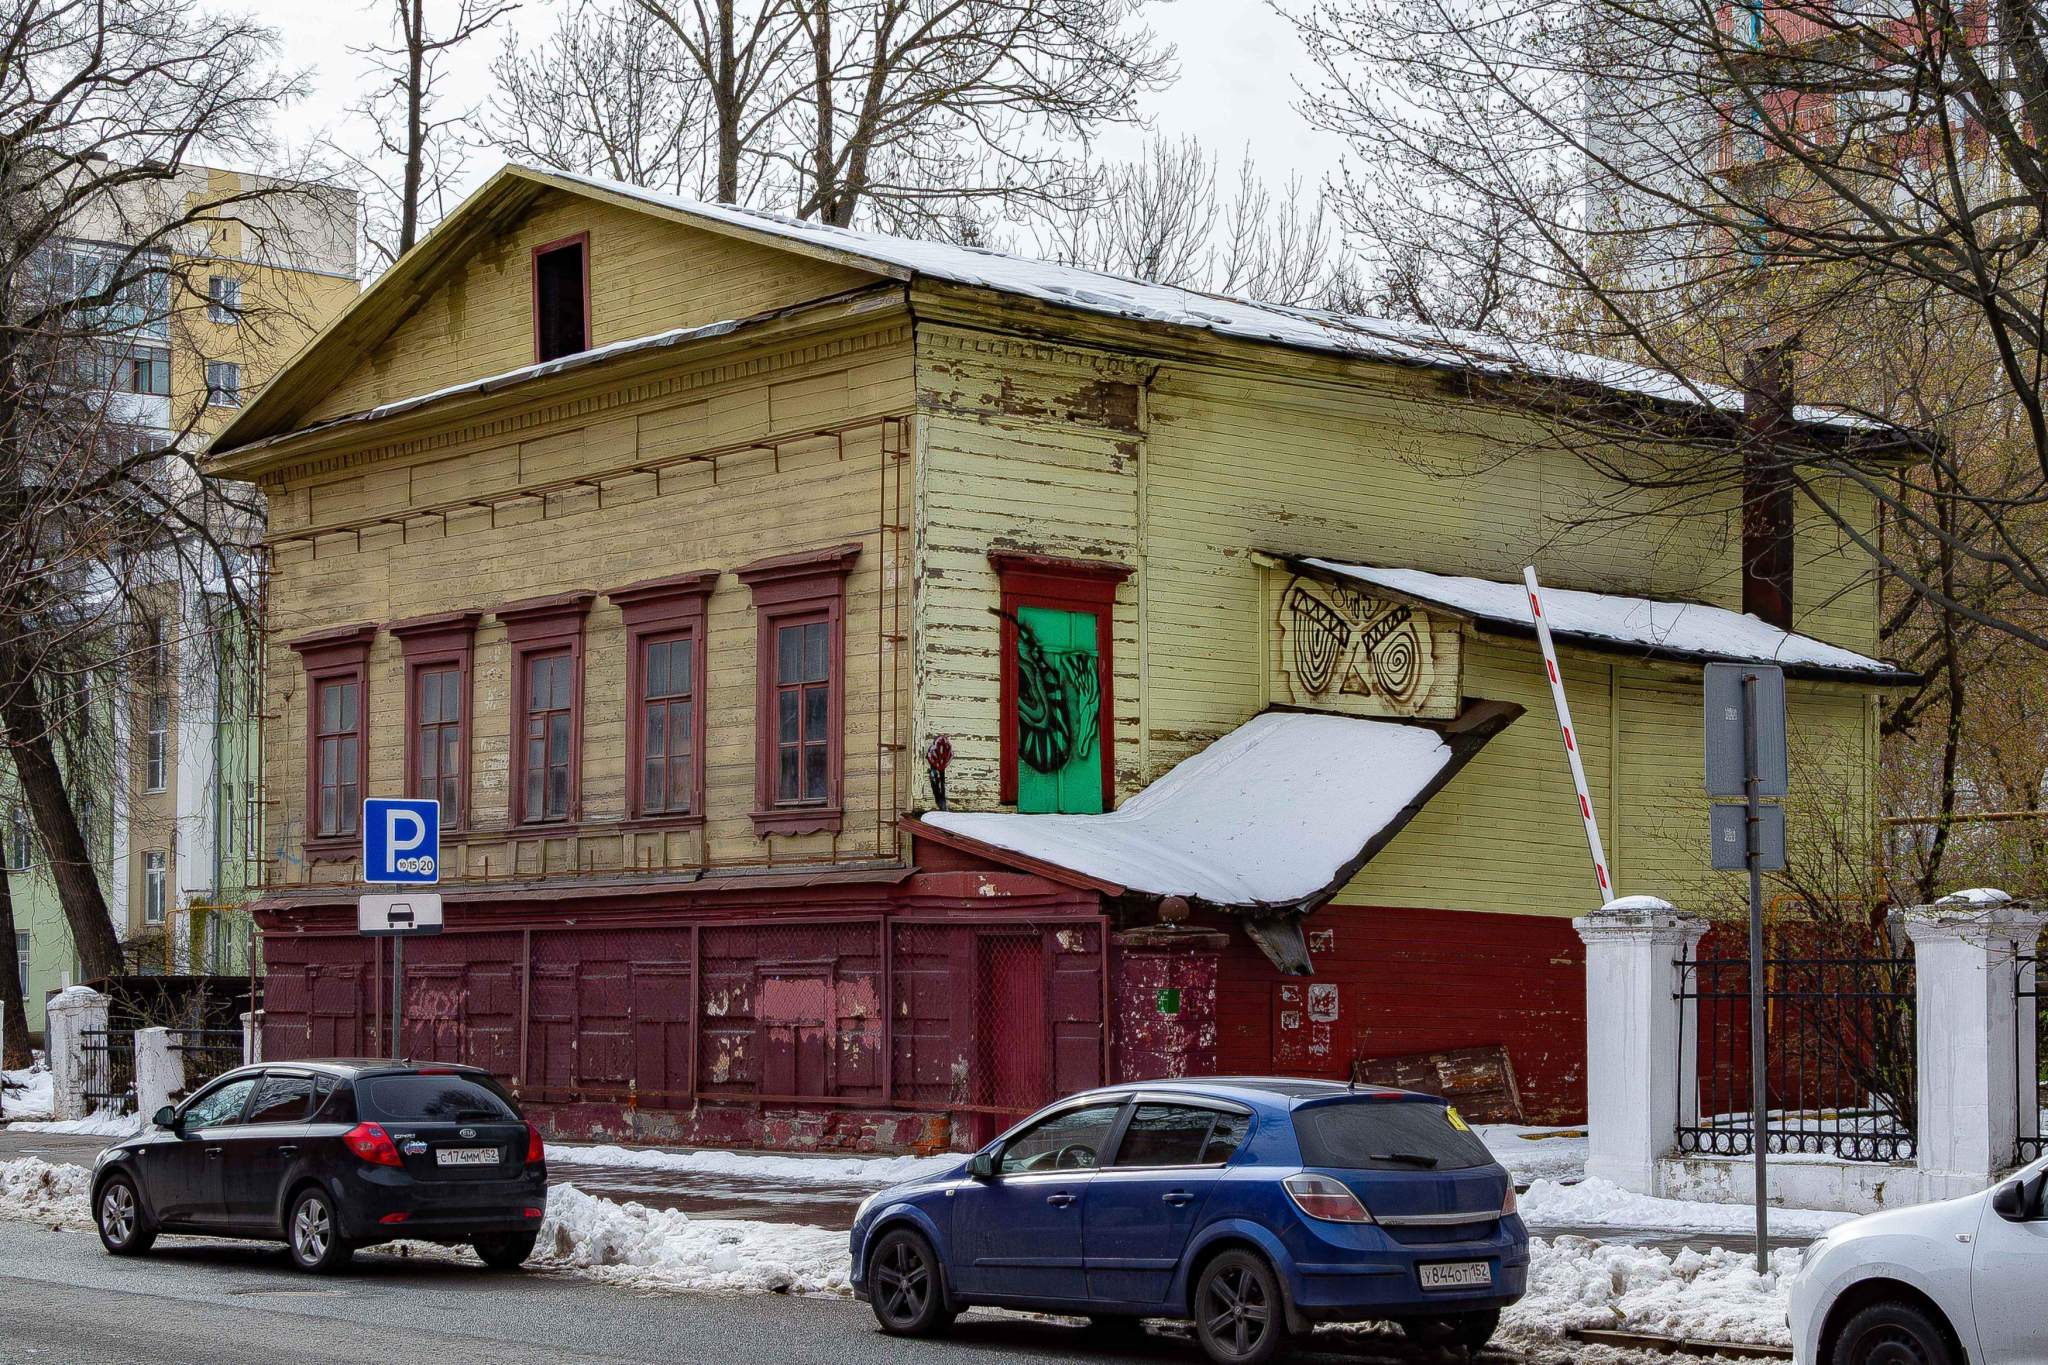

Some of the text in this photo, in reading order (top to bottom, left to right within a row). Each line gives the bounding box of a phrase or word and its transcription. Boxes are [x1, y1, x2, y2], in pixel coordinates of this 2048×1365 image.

[386, 809, 426, 873] P
[408, 860, 417, 870] 15
[420, 860, 433, 871] 20
[481, 1149, 496, 1159] 152
[1471, 1264, 1487, 1277] 152
